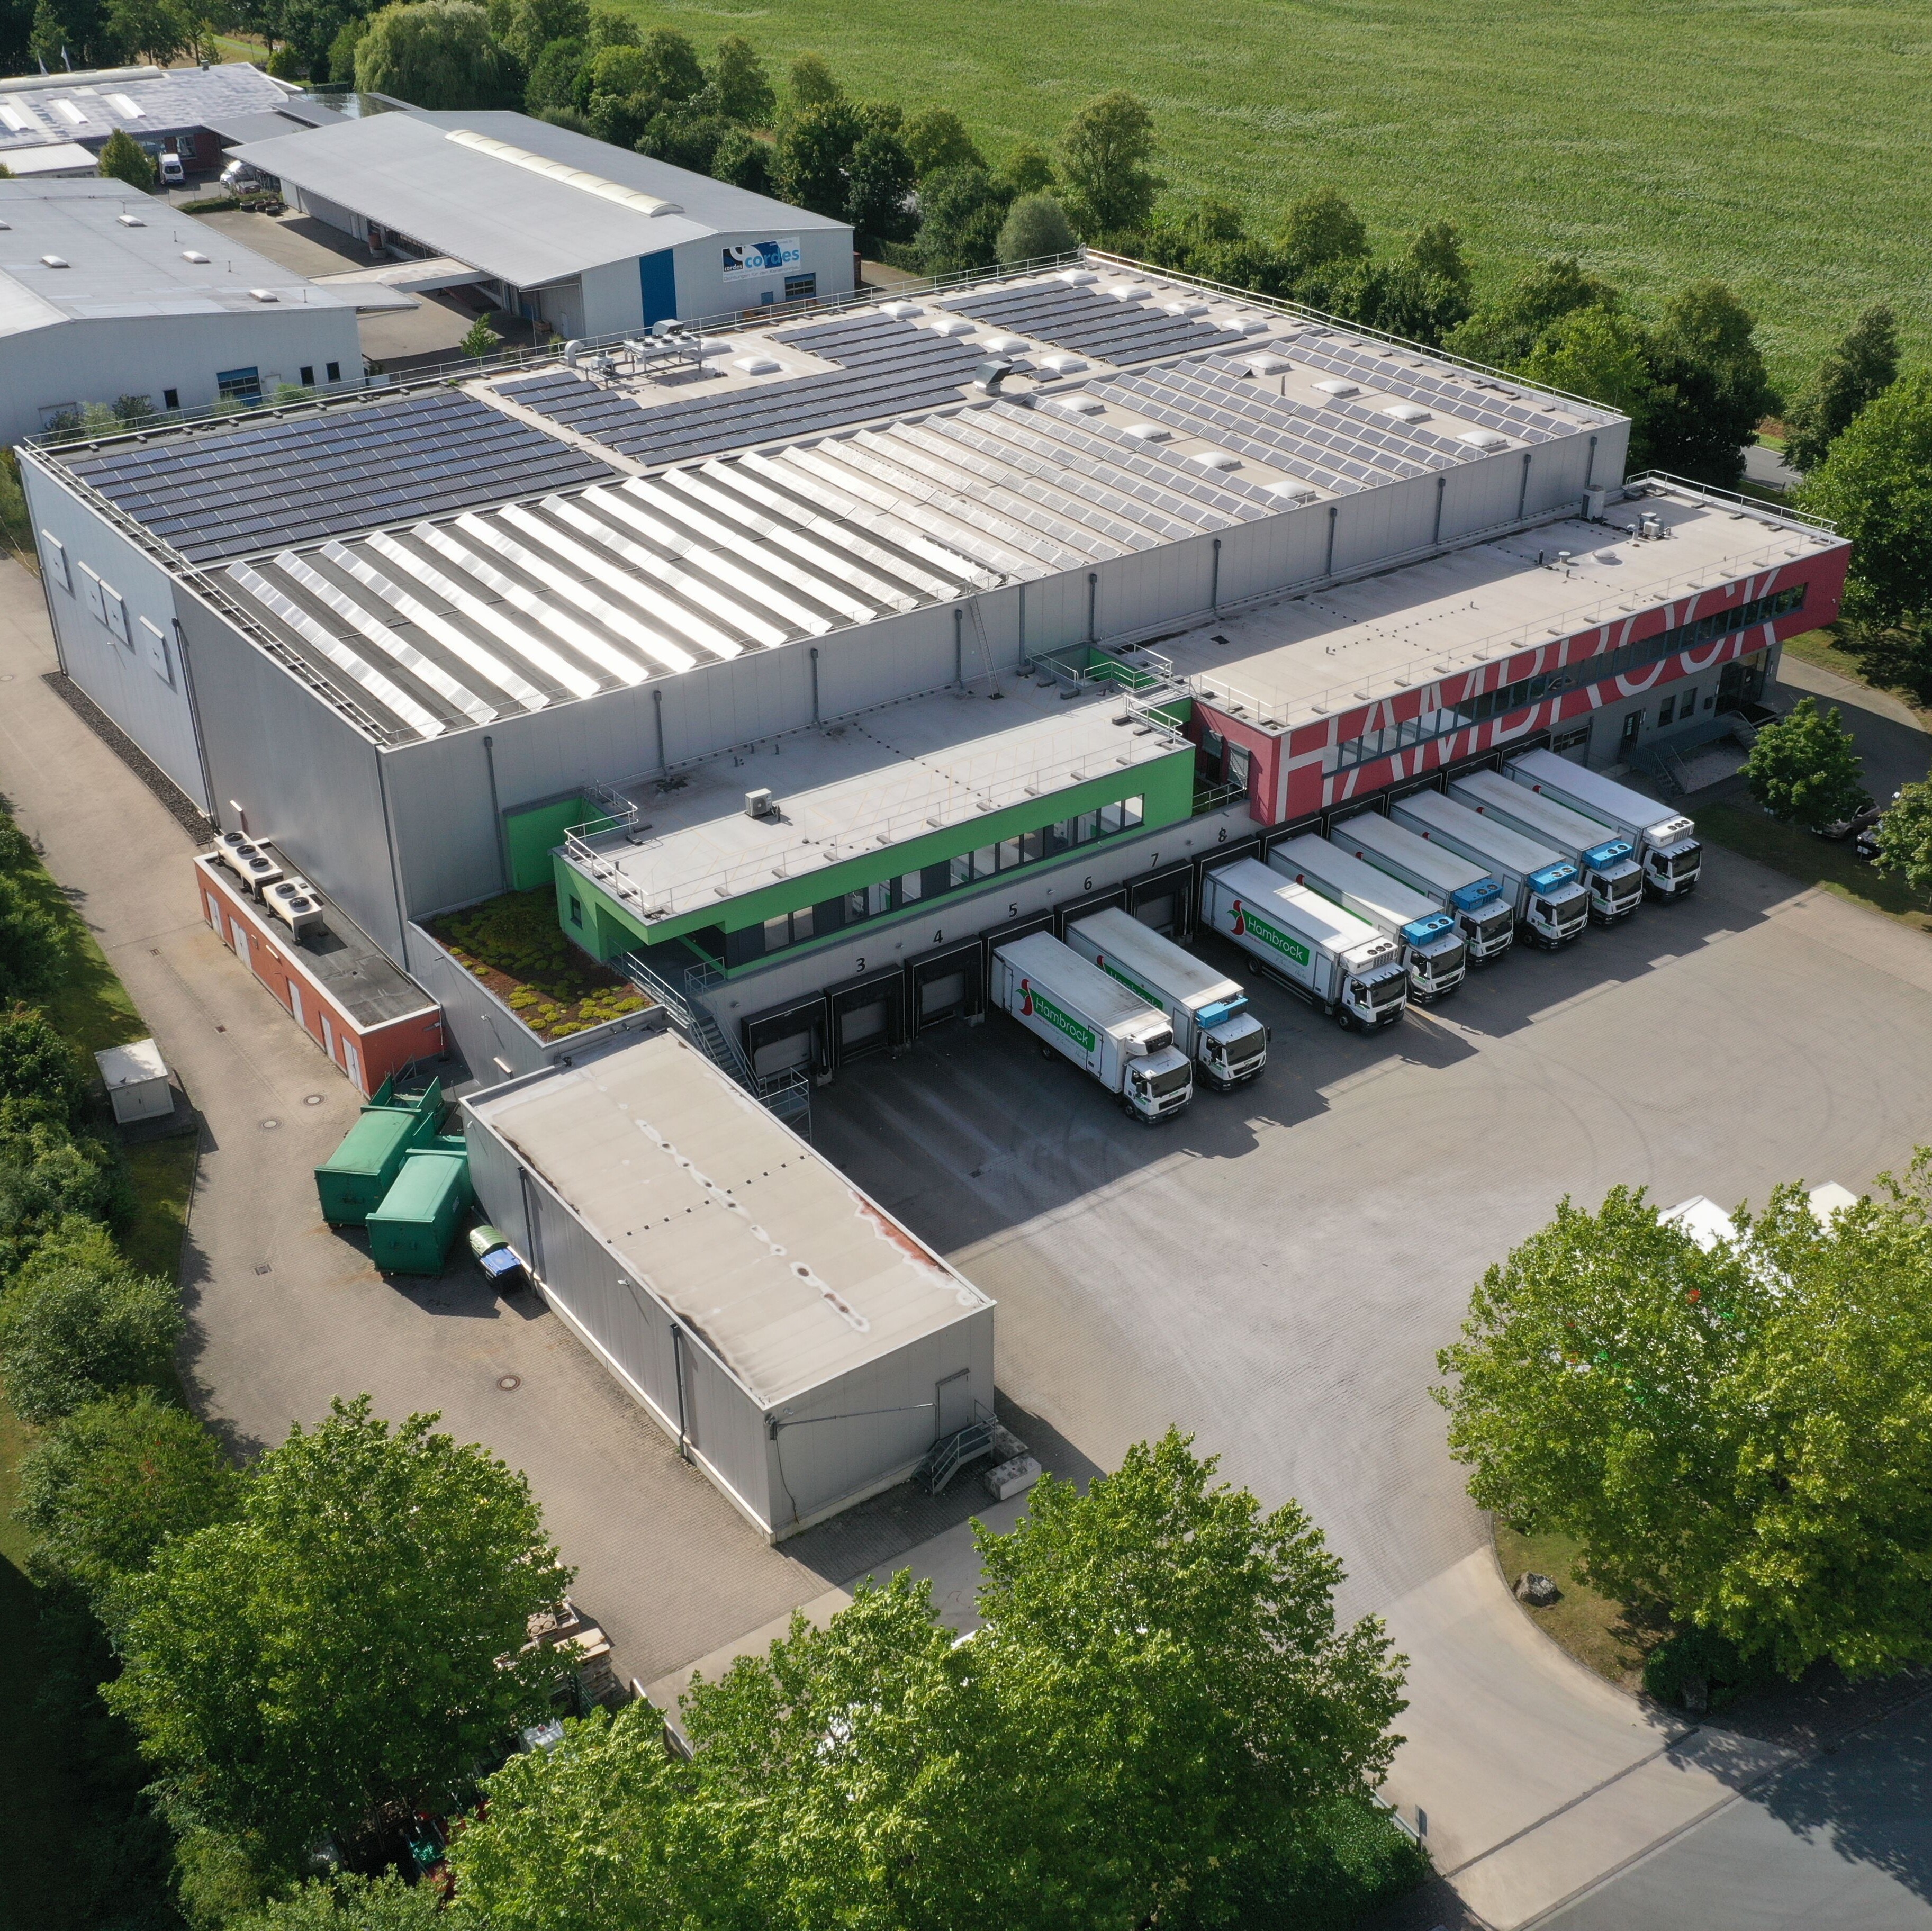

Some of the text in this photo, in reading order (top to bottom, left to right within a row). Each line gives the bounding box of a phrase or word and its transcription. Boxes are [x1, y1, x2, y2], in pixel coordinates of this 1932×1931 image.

[745, 247, 800, 268] cordes
[1275, 567, 1781, 824] HAMBROCK
[1218, 827, 1227, 842] 8
[1151, 852, 1159, 867] 7
[1084, 876, 1092, 890] 6
[1009, 903, 1017, 917] 5
[933, 930, 943, 943] 4
[1248, 917, 1304, 961] Hambrock
[856, 958, 865, 973] 3
[1035, 997, 1089, 1046] Hambrock
